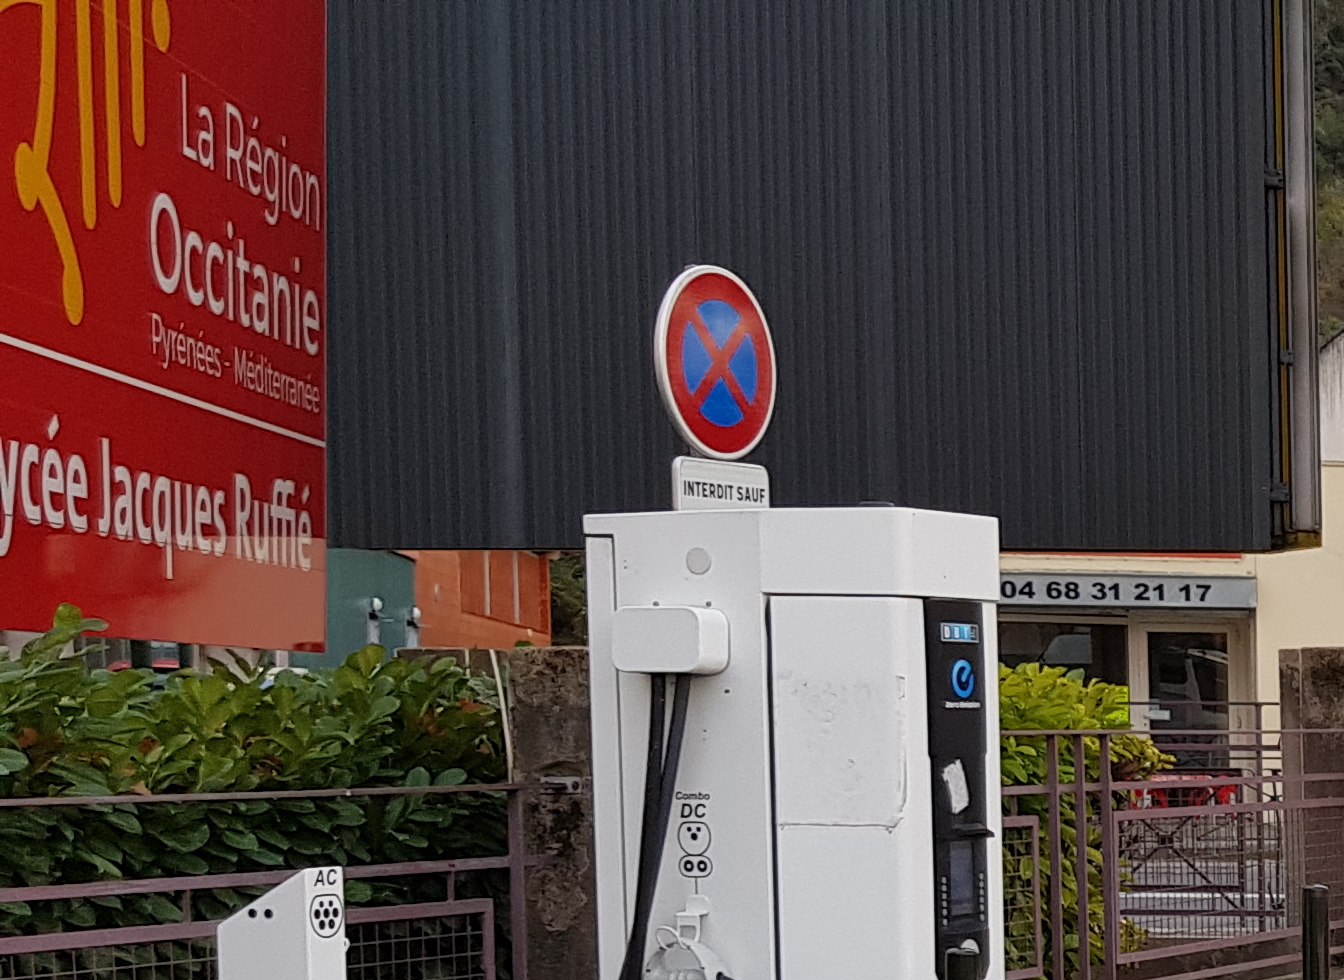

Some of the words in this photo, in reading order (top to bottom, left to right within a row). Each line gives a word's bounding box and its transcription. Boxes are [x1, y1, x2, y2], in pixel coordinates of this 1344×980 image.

[181, 73, 215, 171] La
[225, 102, 321, 231] Région
[150, 193, 320, 356] Occitanie
[151, 312, 222, 378] Pyrénées
[234, 345, 320, 414] Méditerranée
[683, 480, 734, 501] INTERDIT
[737, 486, 766, 503] SAUF
[97, 437, 227, 580] Jacques
[234, 472, 312, 571] Ruffié
[1000, 580, 1036, 599] 04
[1046, 581, 1080, 600] 68
[1091, 582, 1121, 601] 31
[1134, 583, 1166, 601] 21
[1179, 584, 1212, 602] 17
[675, 791, 710, 800] Combo
[680, 803, 706, 818] DC
[313, 869, 337, 887] AC
